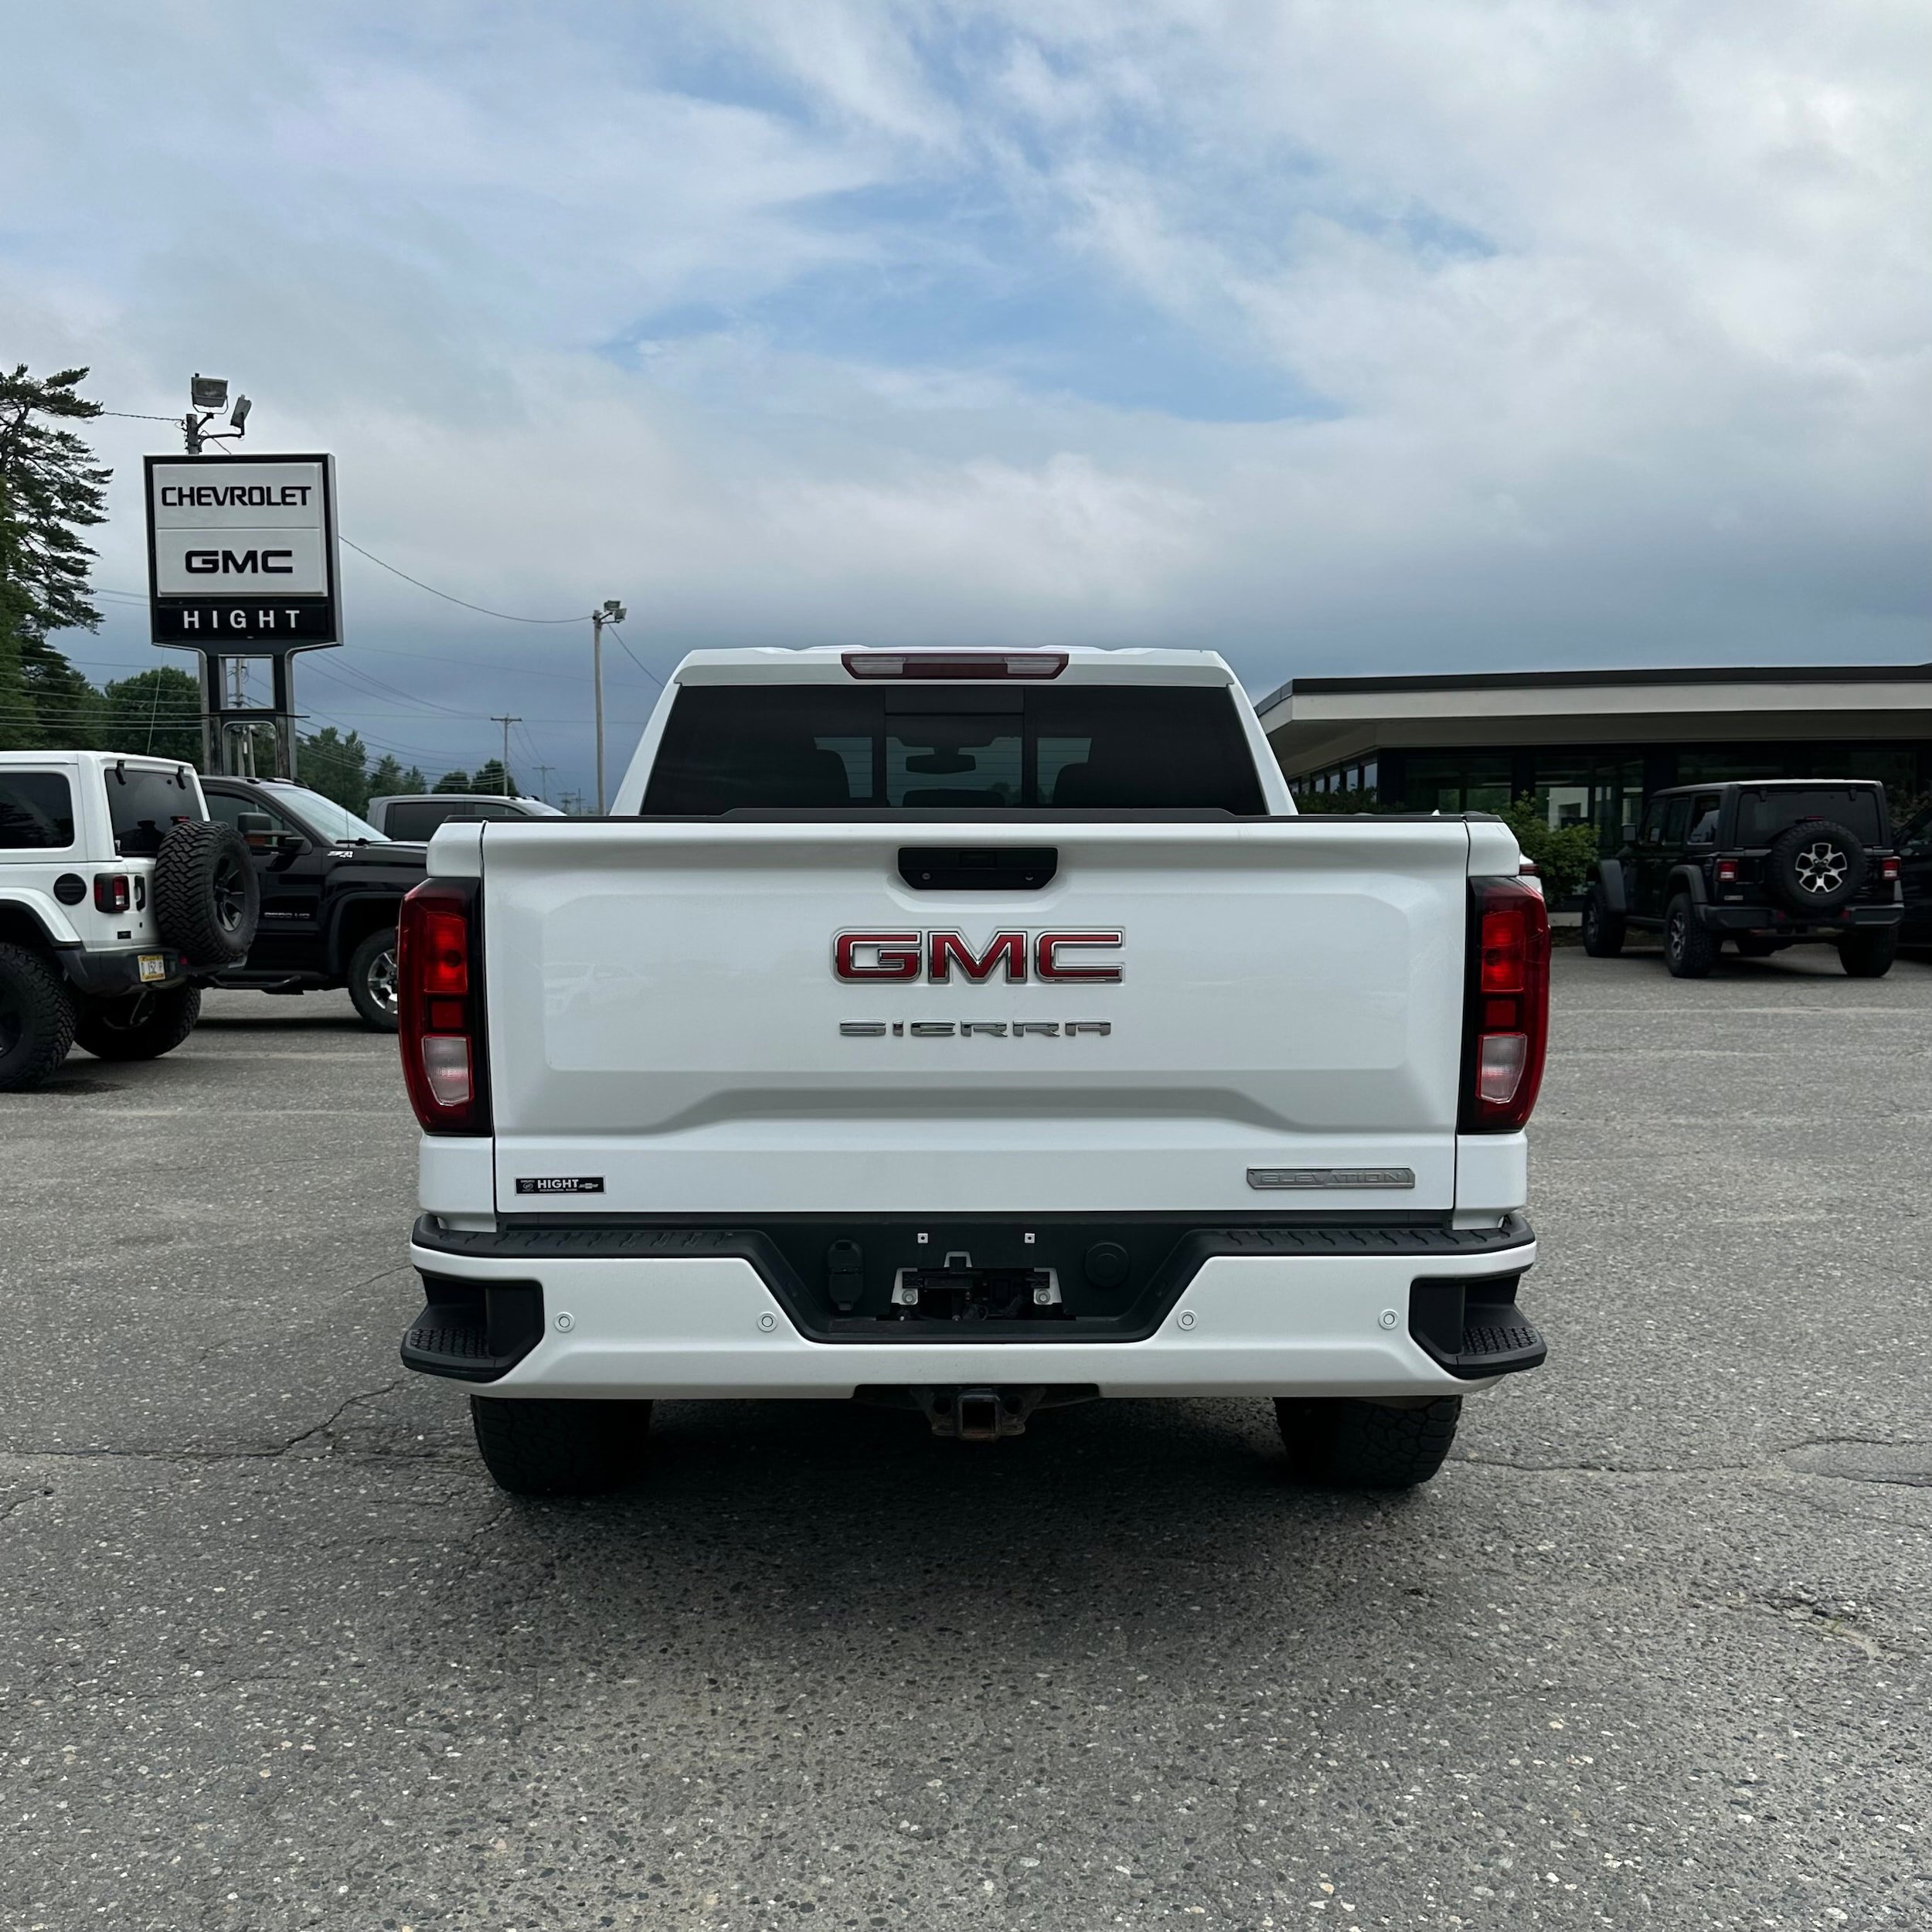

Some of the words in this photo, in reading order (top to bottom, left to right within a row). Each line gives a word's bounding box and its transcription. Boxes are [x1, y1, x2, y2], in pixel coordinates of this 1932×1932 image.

[161, 486, 312, 507] CHEVROLET
[185, 549, 294, 574] GMC
[182, 609, 301, 629] HIGHT
[833, 930, 1124, 985] GMC
[838, 1019, 1112, 1038] SIERRA
[537, 1179, 580, 1189] HIGHT
[1260, 1171, 1403, 1183] ELEVATION
